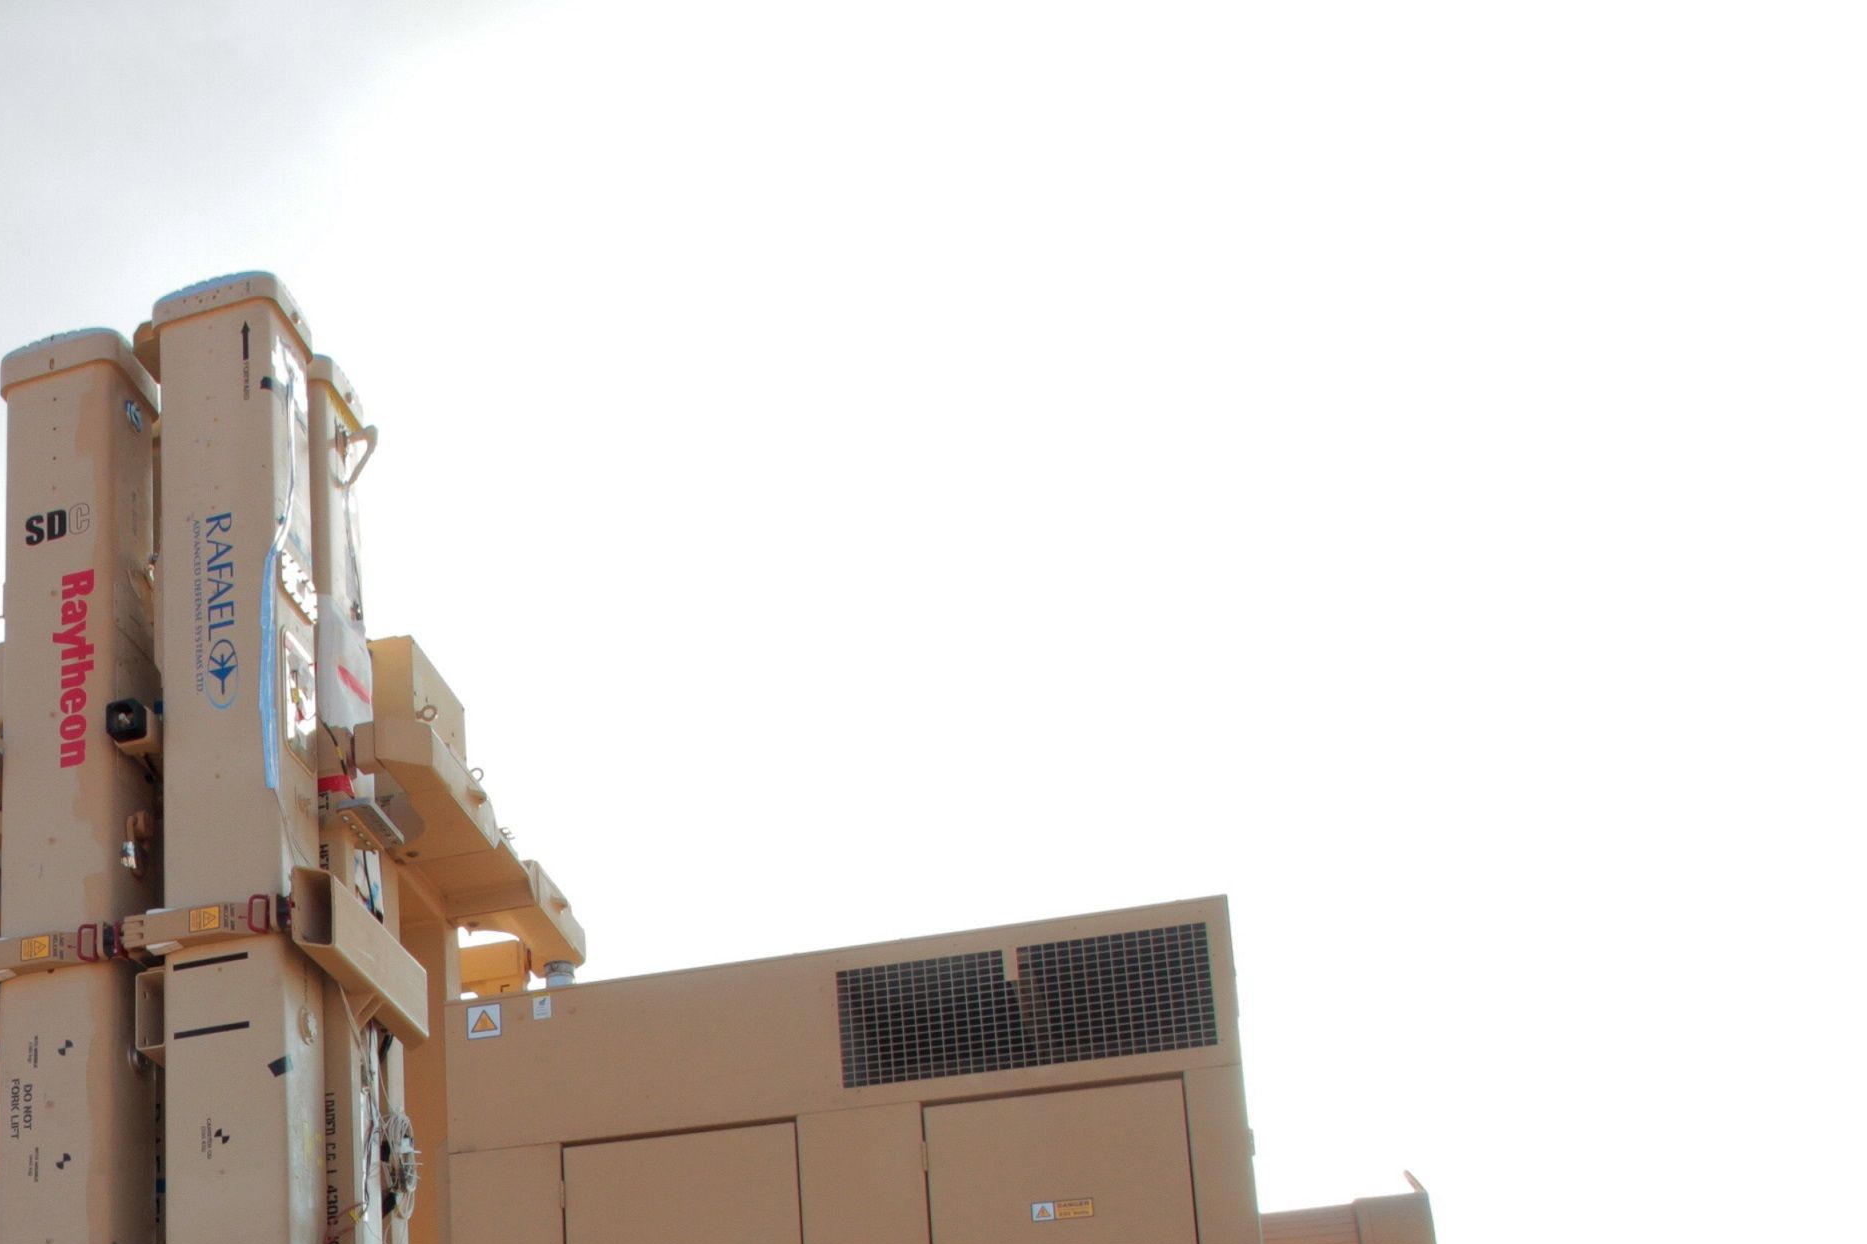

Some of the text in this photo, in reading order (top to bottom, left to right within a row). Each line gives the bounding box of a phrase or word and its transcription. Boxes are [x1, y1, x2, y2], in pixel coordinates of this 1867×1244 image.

[192, 519, 201, 576] ADVANCED
[206, 512, 235, 642] RAFAEL
[52, 568, 95, 769] Raytheon
[196, 626, 204, 669] SYSTEMS
[10, 1078, 20, 1140] FORK LIFT
[23, 1084, 32, 1130] DO NOT
